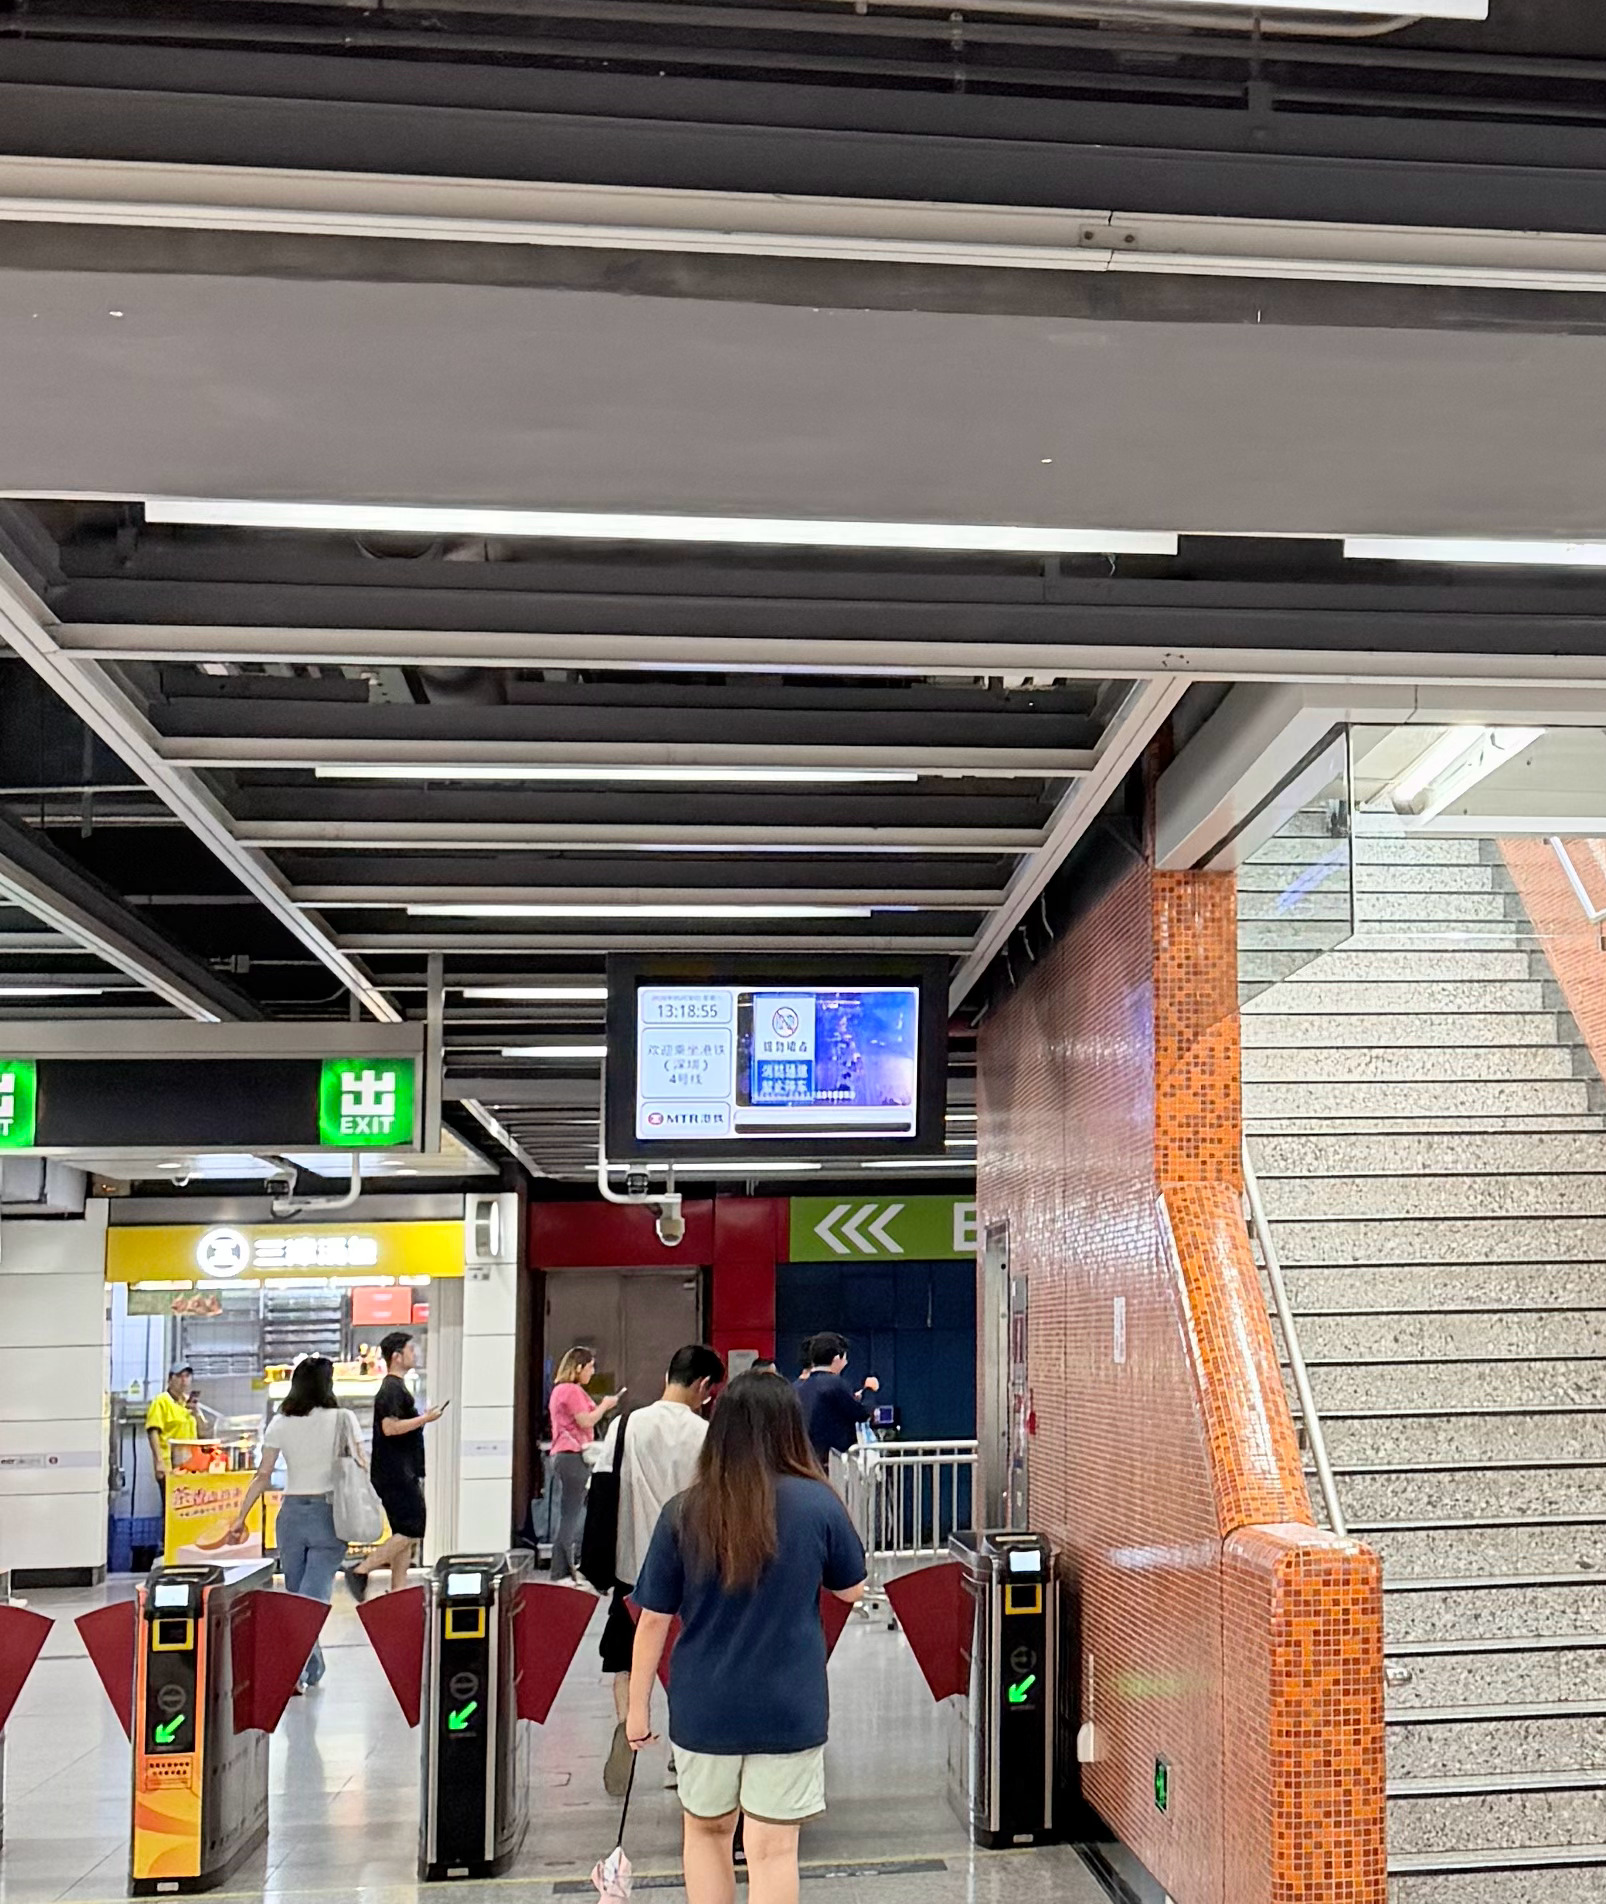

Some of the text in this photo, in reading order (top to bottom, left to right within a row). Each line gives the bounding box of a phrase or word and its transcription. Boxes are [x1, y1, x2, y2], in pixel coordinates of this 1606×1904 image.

[658, 1004, 718, 1018] 13:18:55
[340, 1069, 396, 1116] 出
[340, 1116, 396, 1135] EXIT
